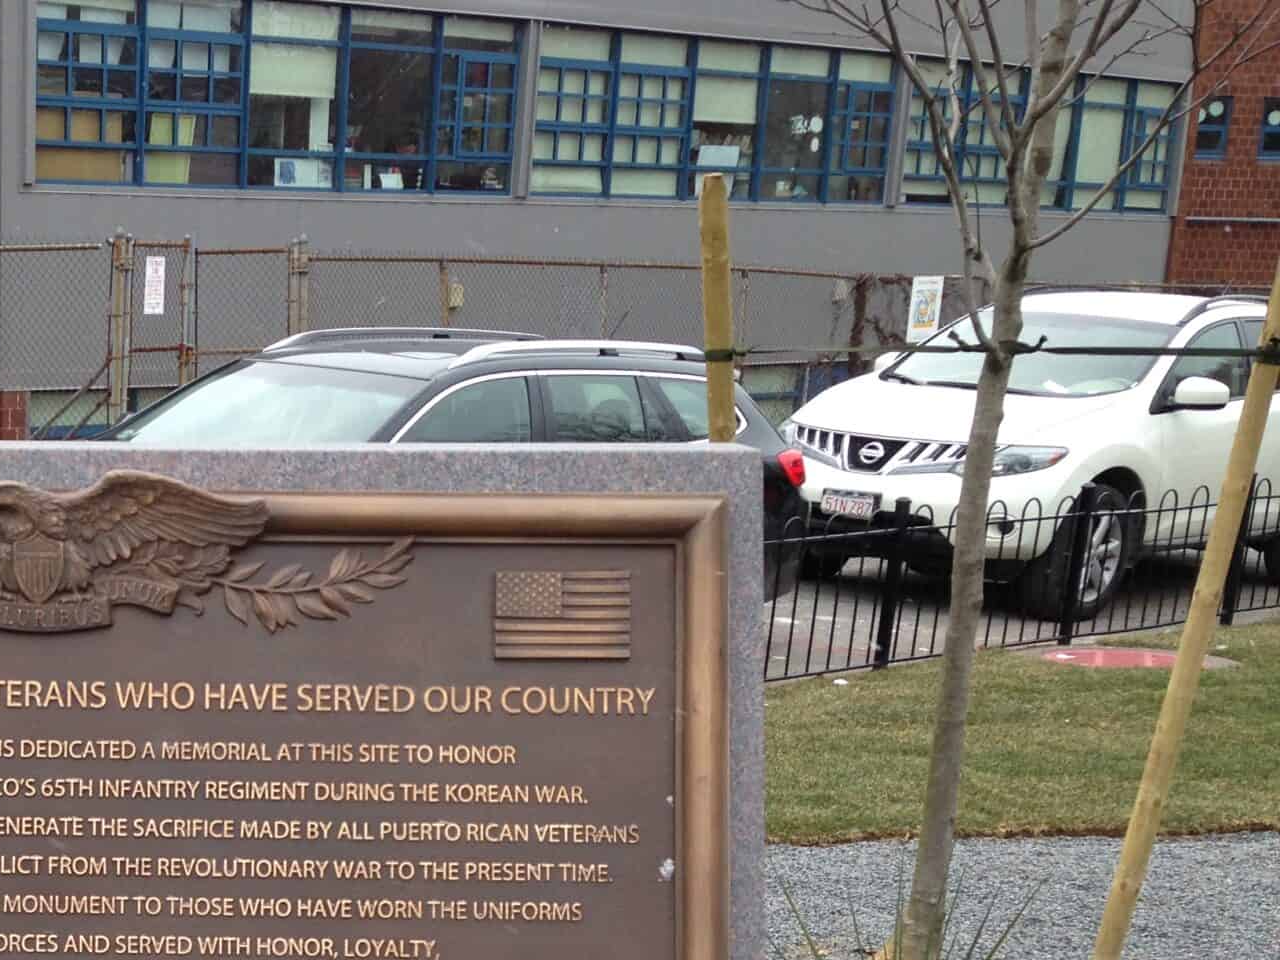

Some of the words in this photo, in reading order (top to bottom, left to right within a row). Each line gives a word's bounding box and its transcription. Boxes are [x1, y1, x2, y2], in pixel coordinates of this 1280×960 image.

[114, 681, 195, 710] WHO
[204, 682, 289, 711] HAVE
[296, 683, 416, 713] SERVED
[423, 685, 493, 713] OUR
[500, 685, 656, 714] COUNTRY
[19, 738, 137, 760] DEDICATED
[140, 740, 156, 760] A
[161, 740, 273, 762] MEMORIAL
[276, 741, 305, 761] AT
[307, 742, 354, 763] THIS
[358, 742, 401, 763] SITE
[402, 743, 434, 764] TO
[438, 743, 517, 765] HONOR
[40, 777, 94, 798] 65TH
[98, 778, 201, 799] INFANTRY
[204, 780, 311, 801] REGIMENT
[314, 781, 395, 802] DURING
[399, 782, 440, 803] THE
[444, 783, 529, 803] KOREAN
[533, 784, 589, 804] WAR.
[87, 816, 129, 837] THE
[132, 817, 235, 839] SACRIFICE
[239, 819, 302, 840] MADE
[306, 819, 333, 840] BY
[336, 820, 376, 841] ALL
[379, 819, 462, 842] PUERTO
[466, 822, 529, 843] RICAN
[533, 823, 640, 844] VETERANS
[47, 854, 108, 876] FROM
[111, 855, 153, 877] THE
[157, 856, 329, 879] REVOLUTIONARY
[332, 859, 382, 880] WAR
[384, 859, 416, 880] TO
[418, 860, 460, 881] THE
[464, 861, 556, 882] PRESENT
[557, 861, 613, 883] TIME.
[2, 893, 129, 915] MONUMENT
[131, 895, 163, 915] TO
[165, 895, 235, 917] THOSE
[238, 897, 292, 917] WHO
[296, 898, 353, 918] HAVE
[356, 898, 423, 919] WORN
[426, 899, 468, 920] THE
[472, 900, 583, 921] UNIFORMS
[63, 933, 111, 954] AND
[114, 933, 193, 955] SERVED
[196, 935, 251, 956] WITH
[256, 936, 339, 960] HONOR,
[343, 937, 441, 960] LOYALTY,
